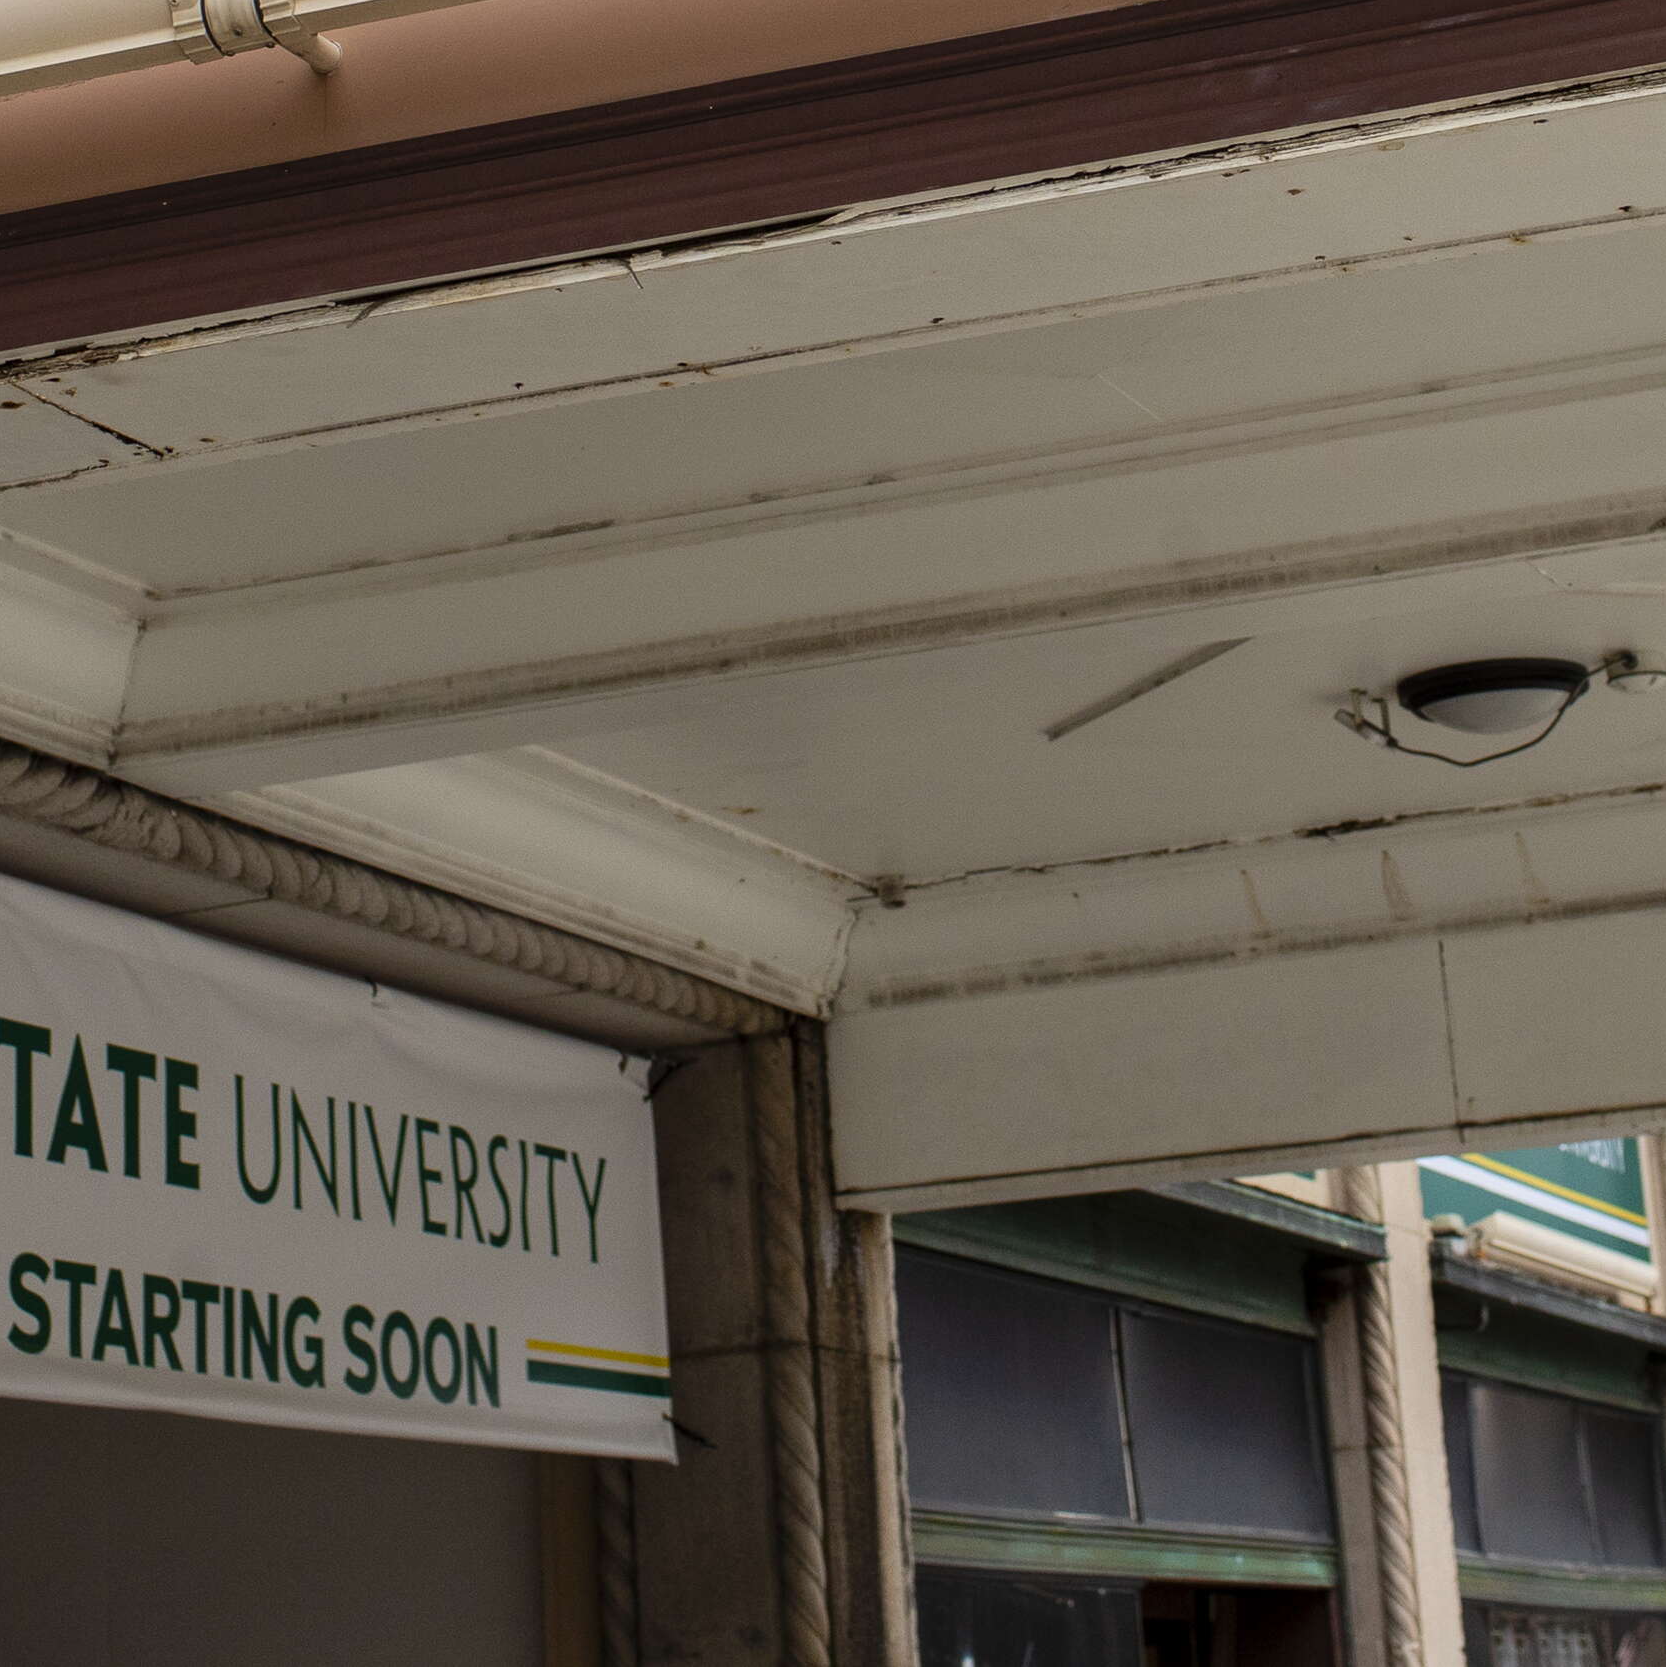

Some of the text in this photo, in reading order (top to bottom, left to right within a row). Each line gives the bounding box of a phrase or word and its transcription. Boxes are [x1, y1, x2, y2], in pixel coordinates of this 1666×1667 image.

[233, 1073, 609, 1267] UNIVERSITY
[6, 1251, 326, 1389] STARTING
[342, 1303, 502, 1410] SOON
